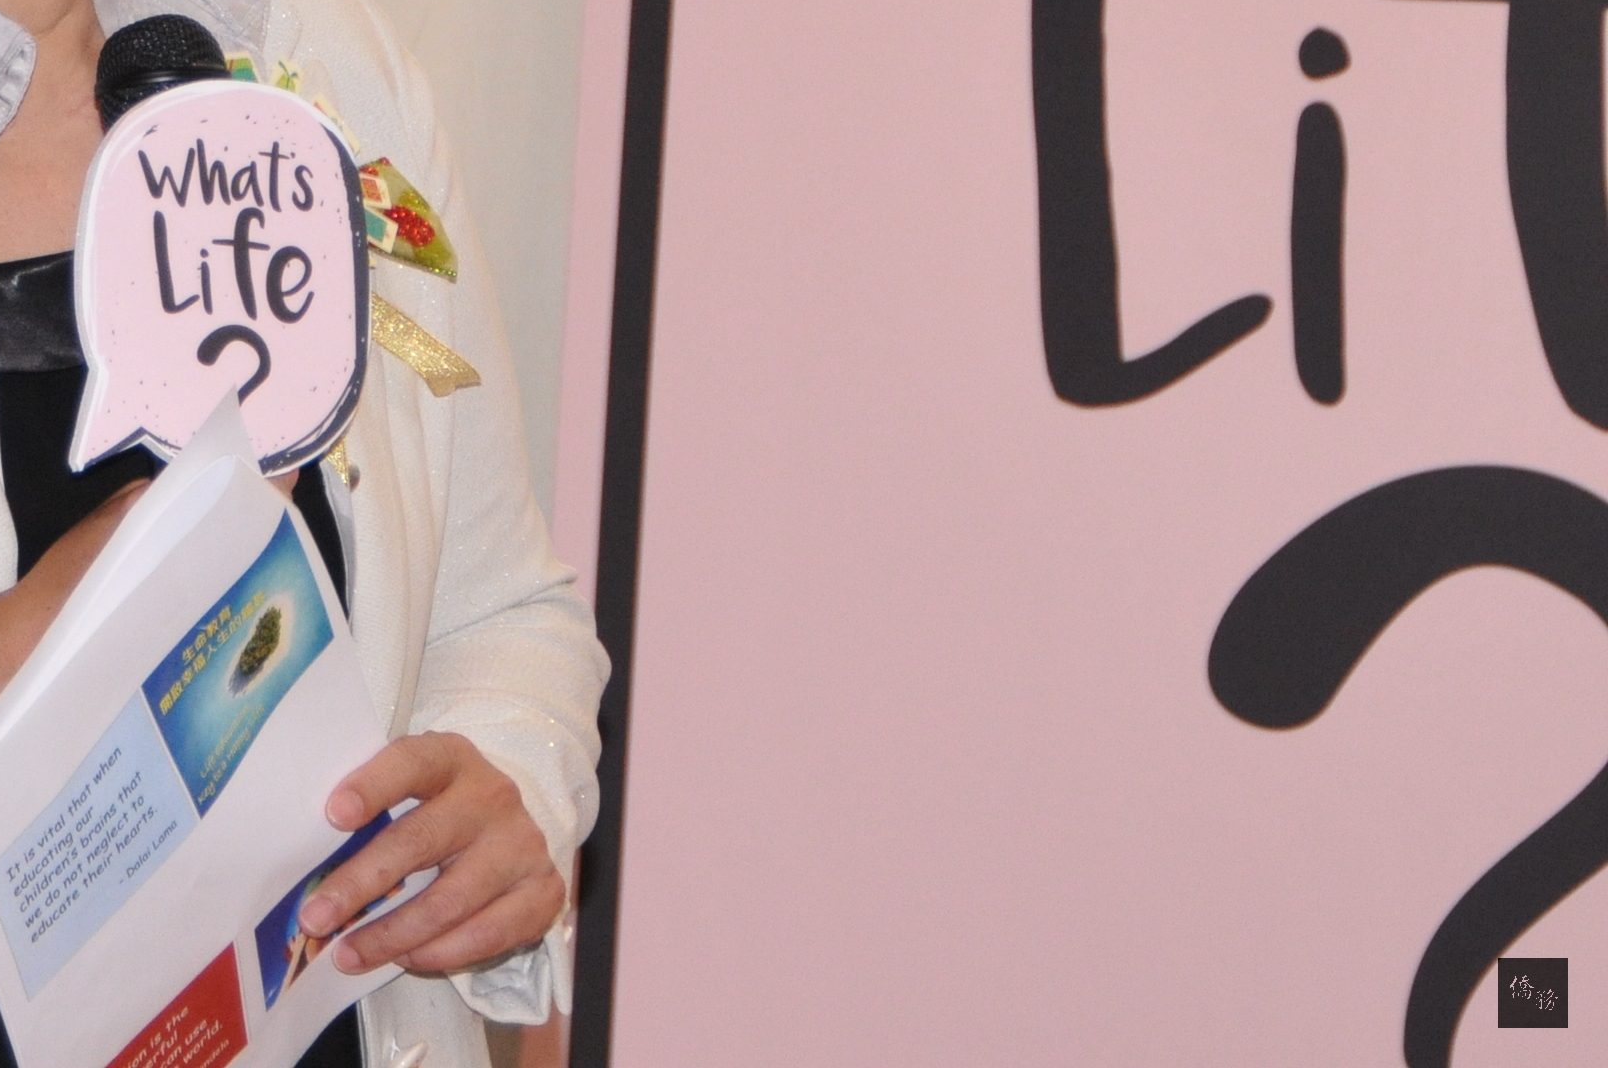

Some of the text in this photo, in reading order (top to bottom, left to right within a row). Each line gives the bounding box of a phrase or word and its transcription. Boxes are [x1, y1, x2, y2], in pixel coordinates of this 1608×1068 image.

[137, 138, 314, 213] What's
[153, 207, 315, 324] Life
[182, 604, 231, 666] 生命教育
[5, 746, 122, 882] It is vital that when
[13, 805, 94, 897] educating our
[19, 770, 143, 913] children's brains that
[126, 846, 152, 878] Dalai
[152, 818, 178, 851] Lama
[25, 795, 145, 929] we do not neglect to
[31, 805, 158, 943] educate their hearts.
[150, 1031, 162, 1049] is
[165, 1005, 189, 1032] the
[184, 1018, 208, 1045] use
